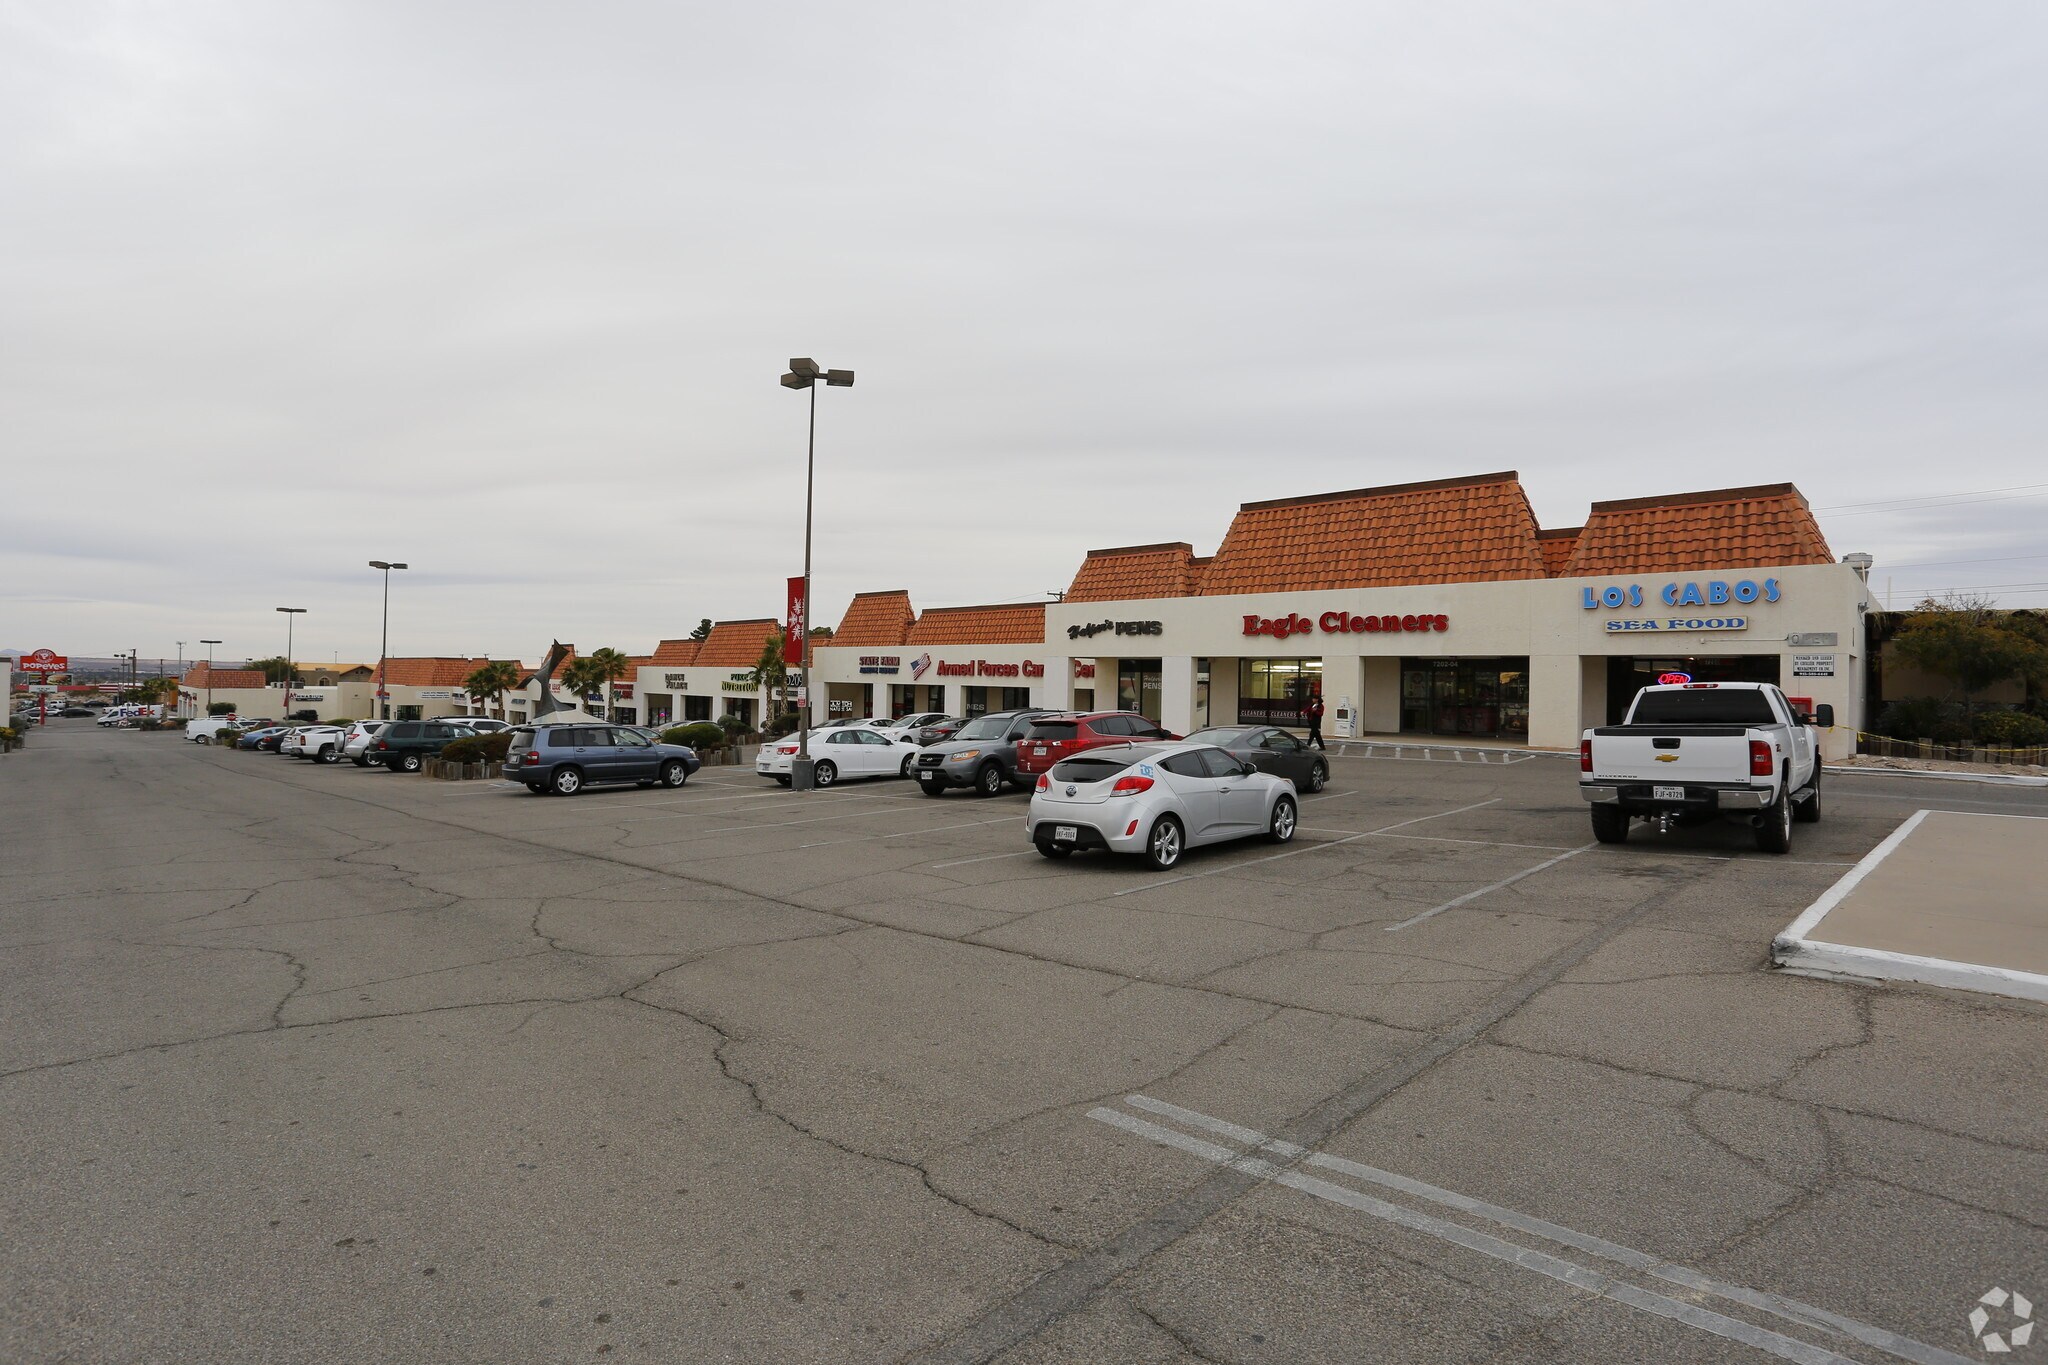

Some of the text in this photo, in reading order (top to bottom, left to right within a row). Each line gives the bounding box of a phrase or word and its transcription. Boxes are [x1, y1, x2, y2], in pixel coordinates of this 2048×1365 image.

[1583, 578, 1781, 609] LOS CABOS
[1115, 621, 1163, 636] PENS
[1242, 611, 1449, 639] Eagle Cleaners
[1606, 618, 1745, 631] SEA FOOD
[859, 656, 879, 666] STATE
[937, 660, 975, 676] Armed
[977, 660, 1019, 677] Forces
[1022, 660, 1044, 677] Car
[1659, 673, 1688, 684] OPEN
[721, 681, 758, 692] NUTRITION
[1143, 682, 1162, 690] PENS
[120, 707, 155, 718] FedEx
[1240, 709, 1266, 717] CLEANERS
[1270, 710, 1297, 718] CLEANERS
